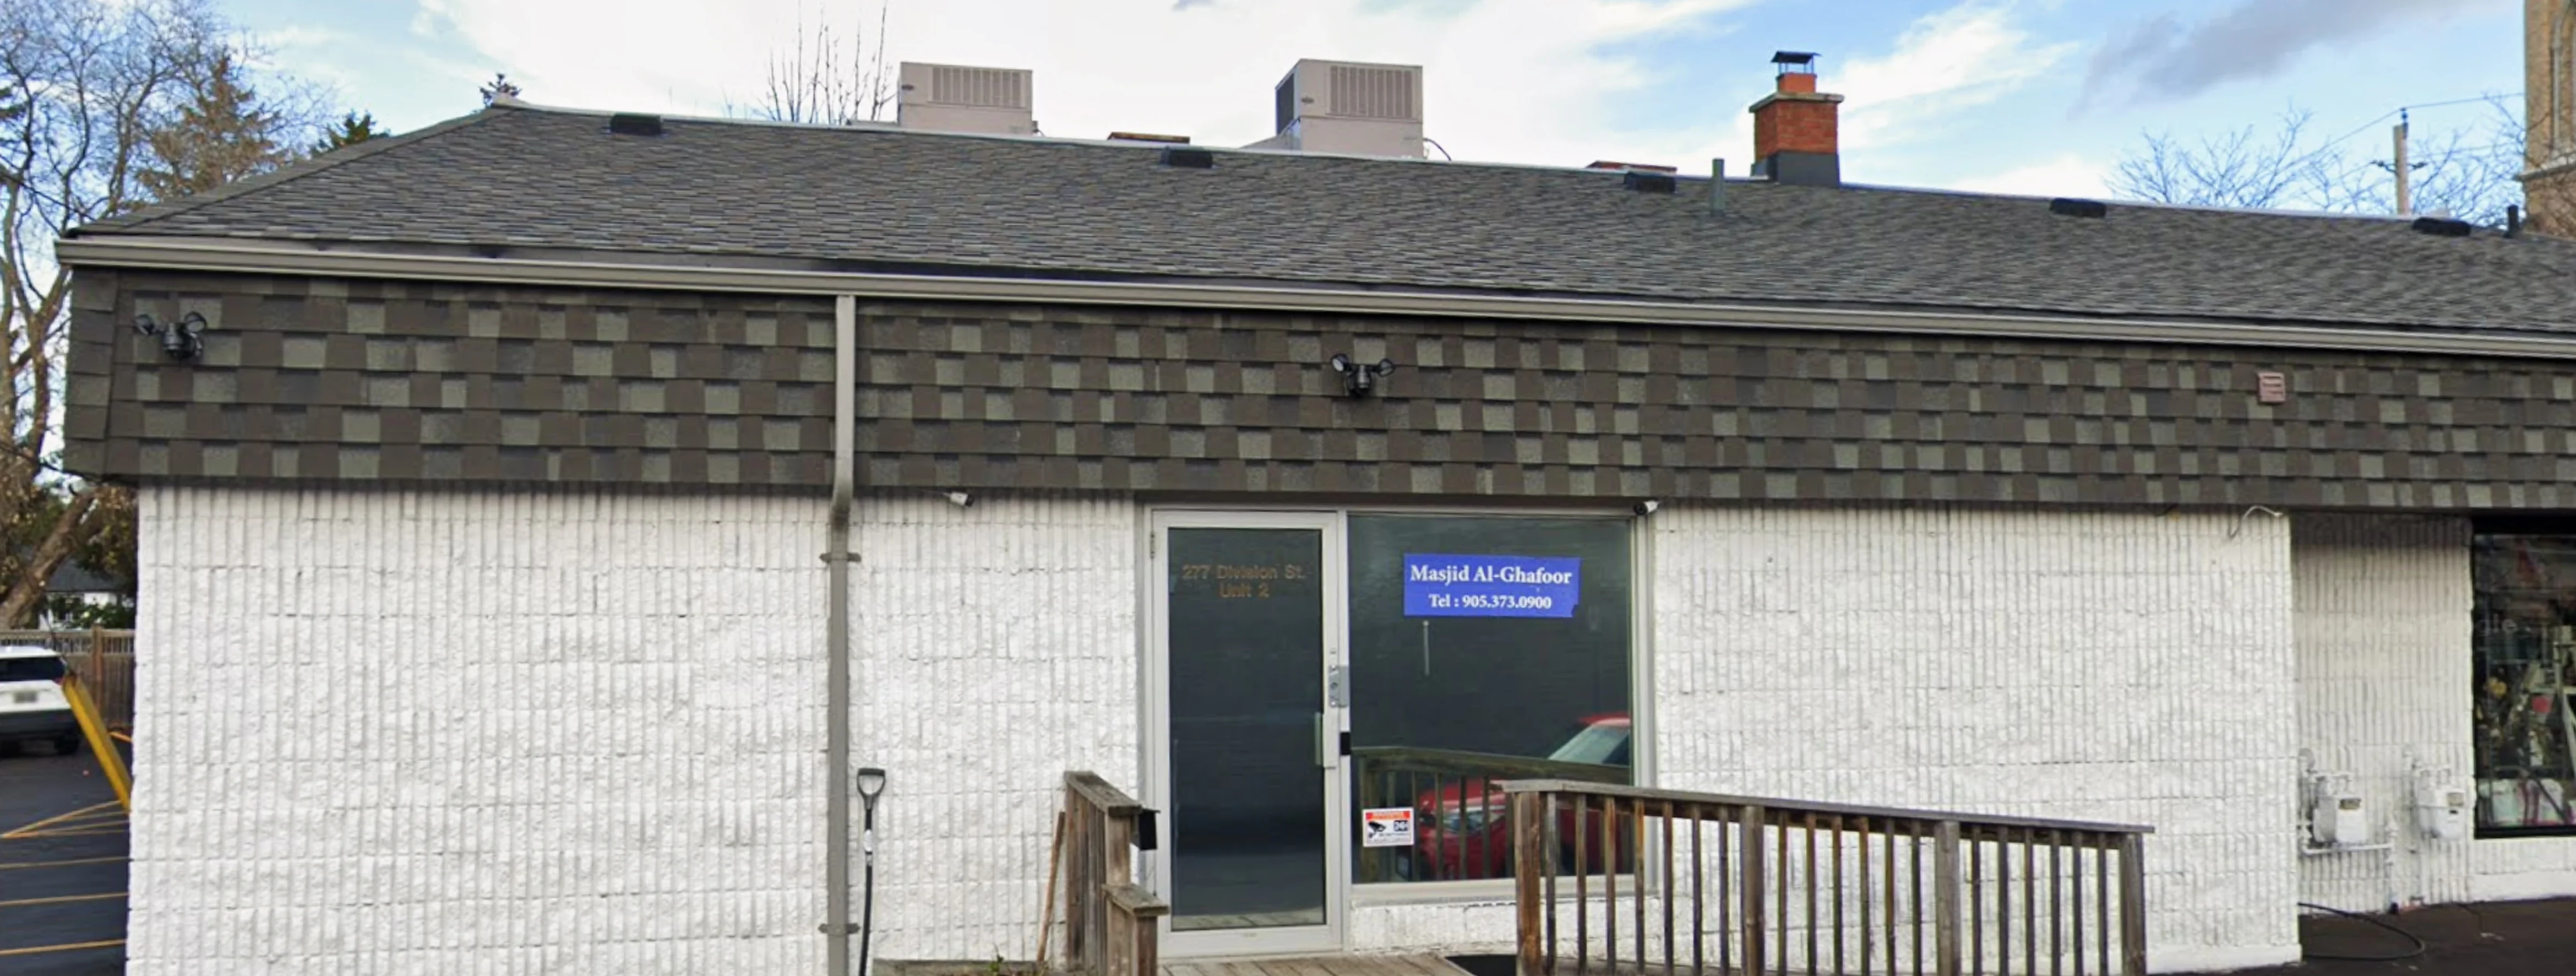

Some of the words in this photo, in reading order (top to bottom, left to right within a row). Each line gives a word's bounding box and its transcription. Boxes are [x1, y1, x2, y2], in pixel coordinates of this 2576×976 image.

[1183, 564, 1210, 580] 277
[1217, 565, 1277, 580] Division
[1410, 565, 1470, 586] Masjid
[1473, 565, 1572, 584] Al-Ghafoor
[1218, 583, 1252, 598] Unit
[1258, 583, 1270, 598] 2
[1429, 594, 1451, 608] Tel
[1462, 594, 1552, 609] 905.373.0900
